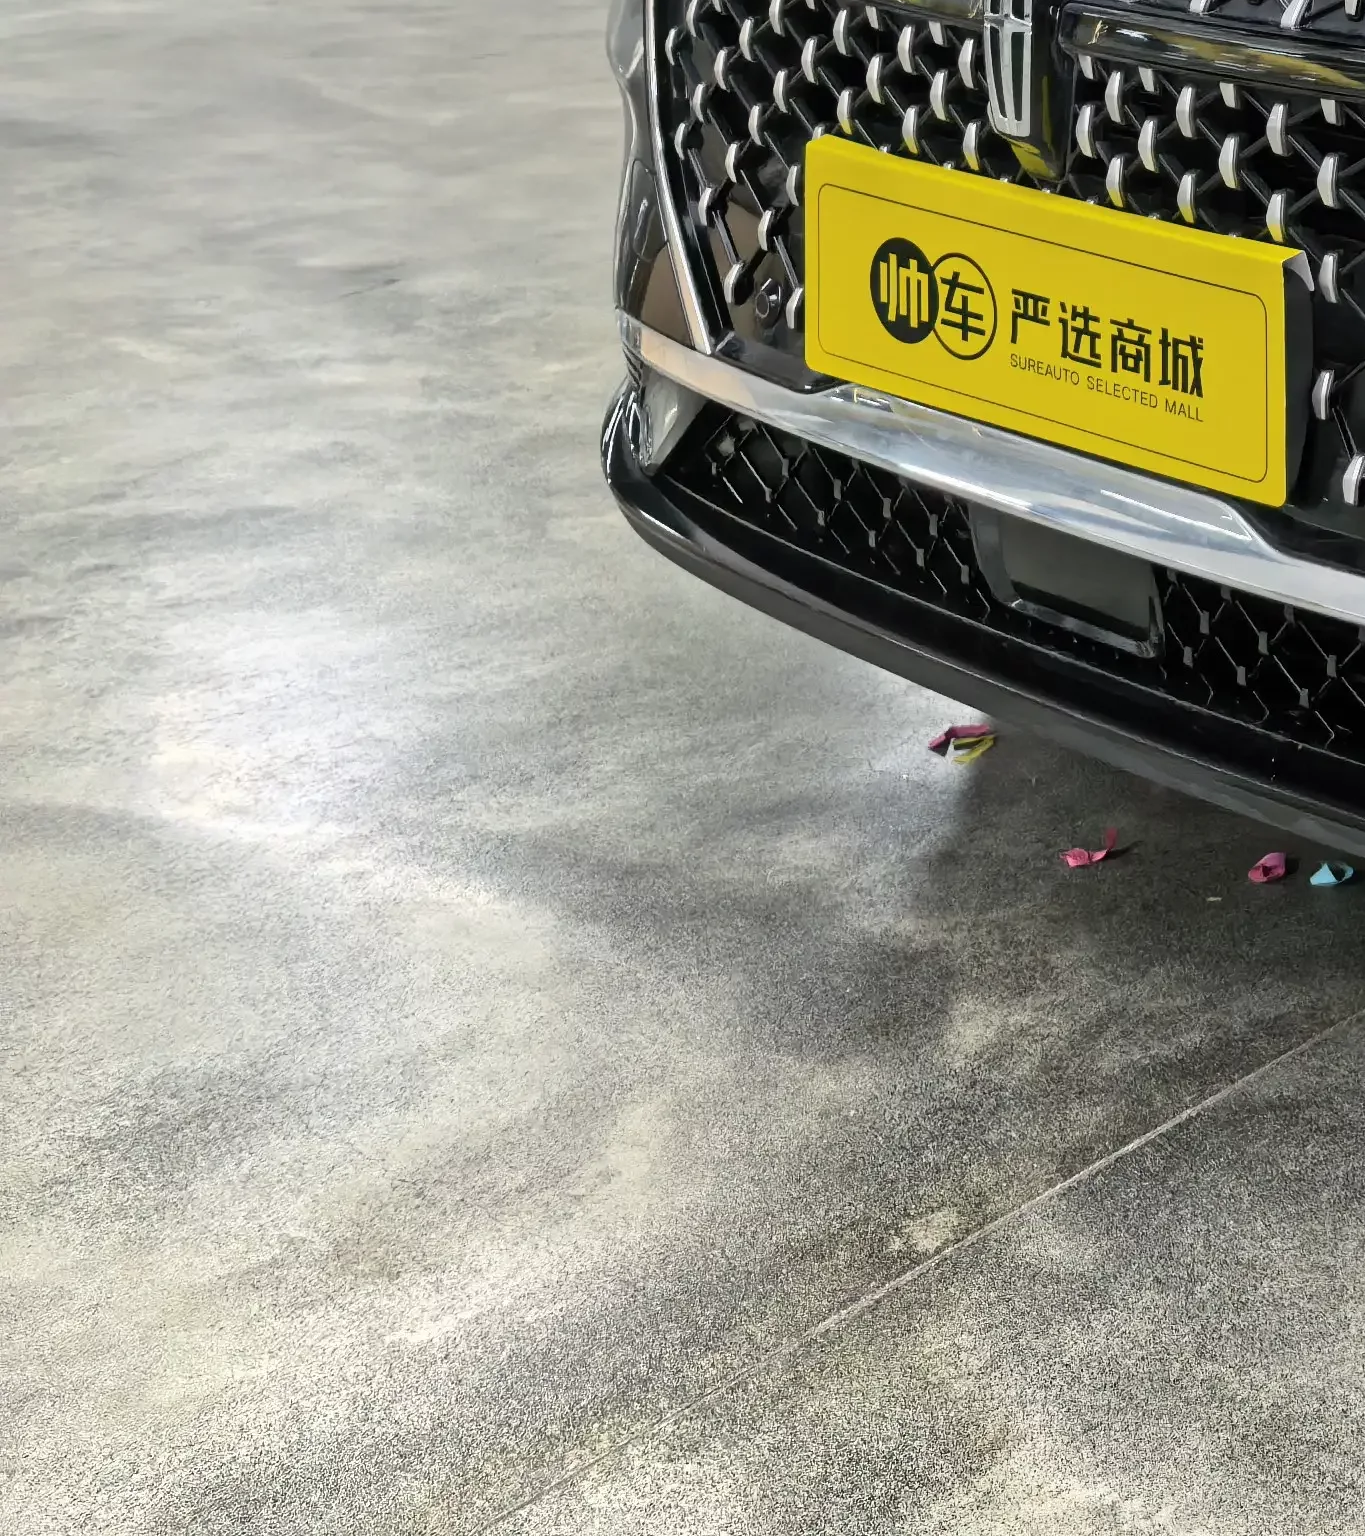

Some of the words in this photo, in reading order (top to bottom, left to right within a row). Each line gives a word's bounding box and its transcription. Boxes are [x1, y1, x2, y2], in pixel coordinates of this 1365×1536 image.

[1010, 352, 1080, 386] SUREAUTO
[1086, 375, 1158, 410] SELECTED
[1164, 398, 1205, 423] MALL
[1011, 287, 1205, 399] 严选商城
